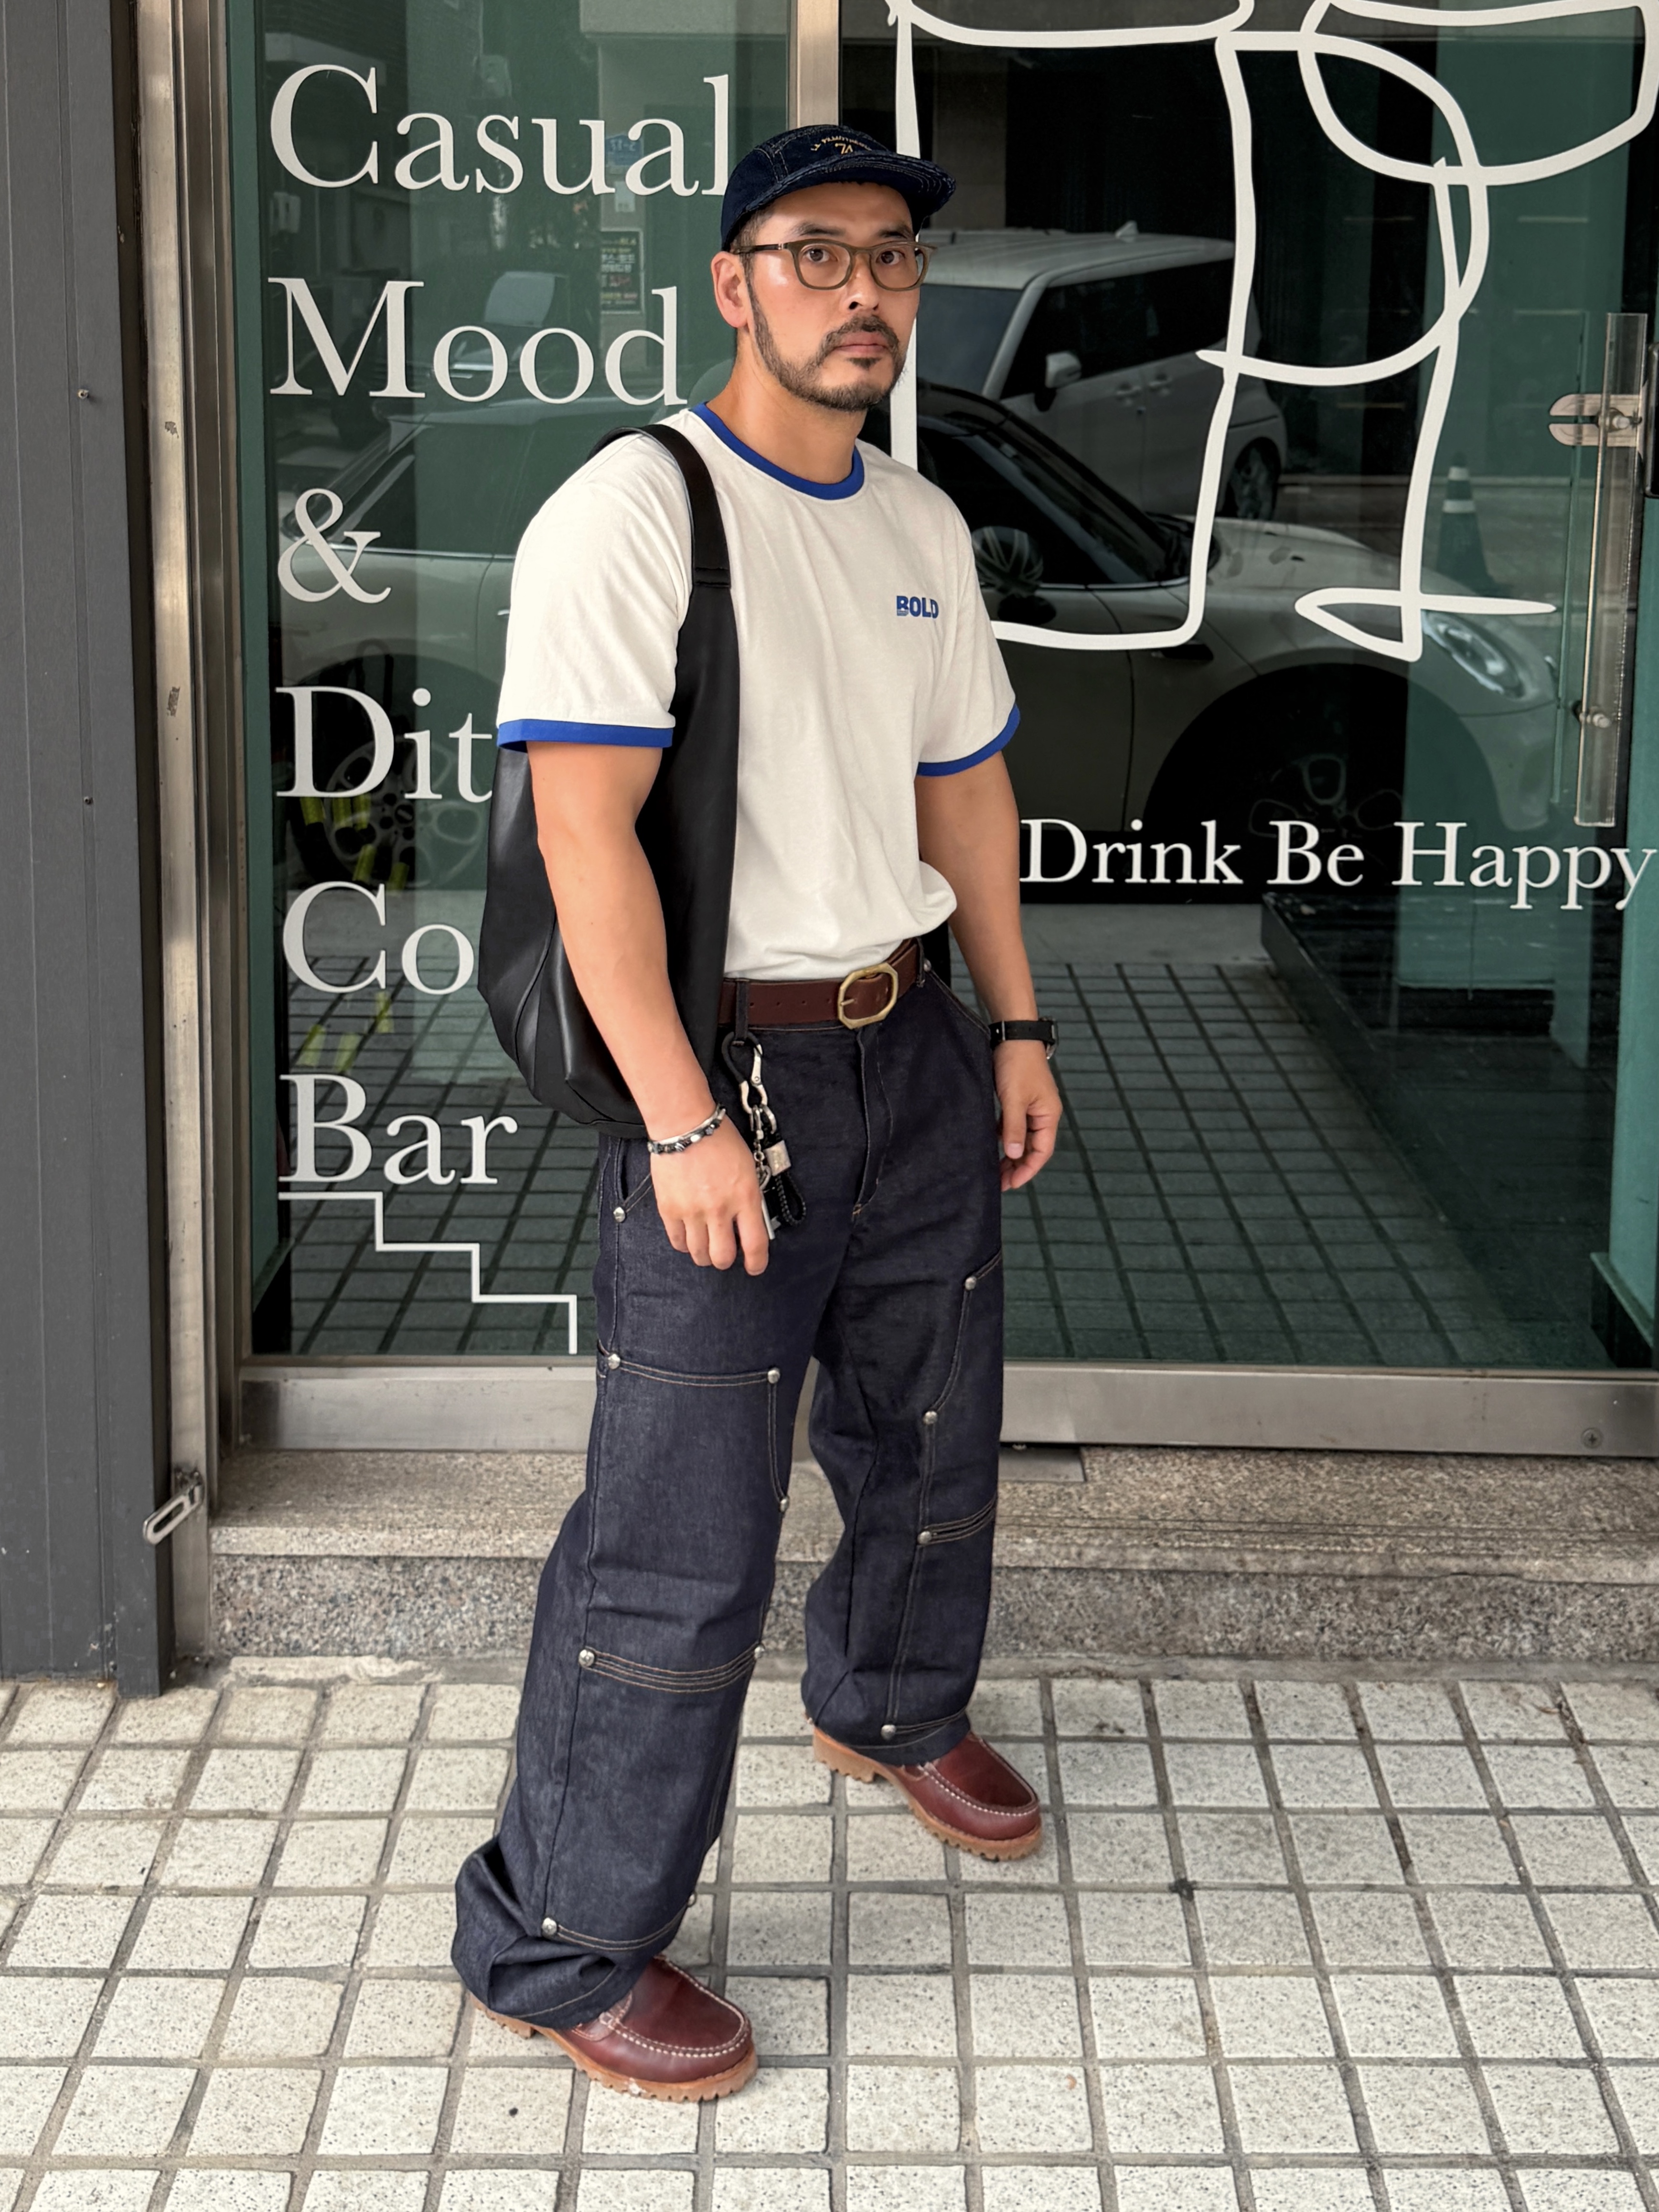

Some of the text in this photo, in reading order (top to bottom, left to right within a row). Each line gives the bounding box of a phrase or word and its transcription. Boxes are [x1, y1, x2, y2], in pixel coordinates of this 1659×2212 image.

[270, 64, 729, 197] Casual
[268, 277, 689, 407] Mood
[277, 488, 392, 604] &
[896, 595, 939, 619] BOLD
[1019, 818, 1658, 911] Drink Be Happy
[282, 881, 475, 996] Co
[278, 1074, 518, 1185] Bar
